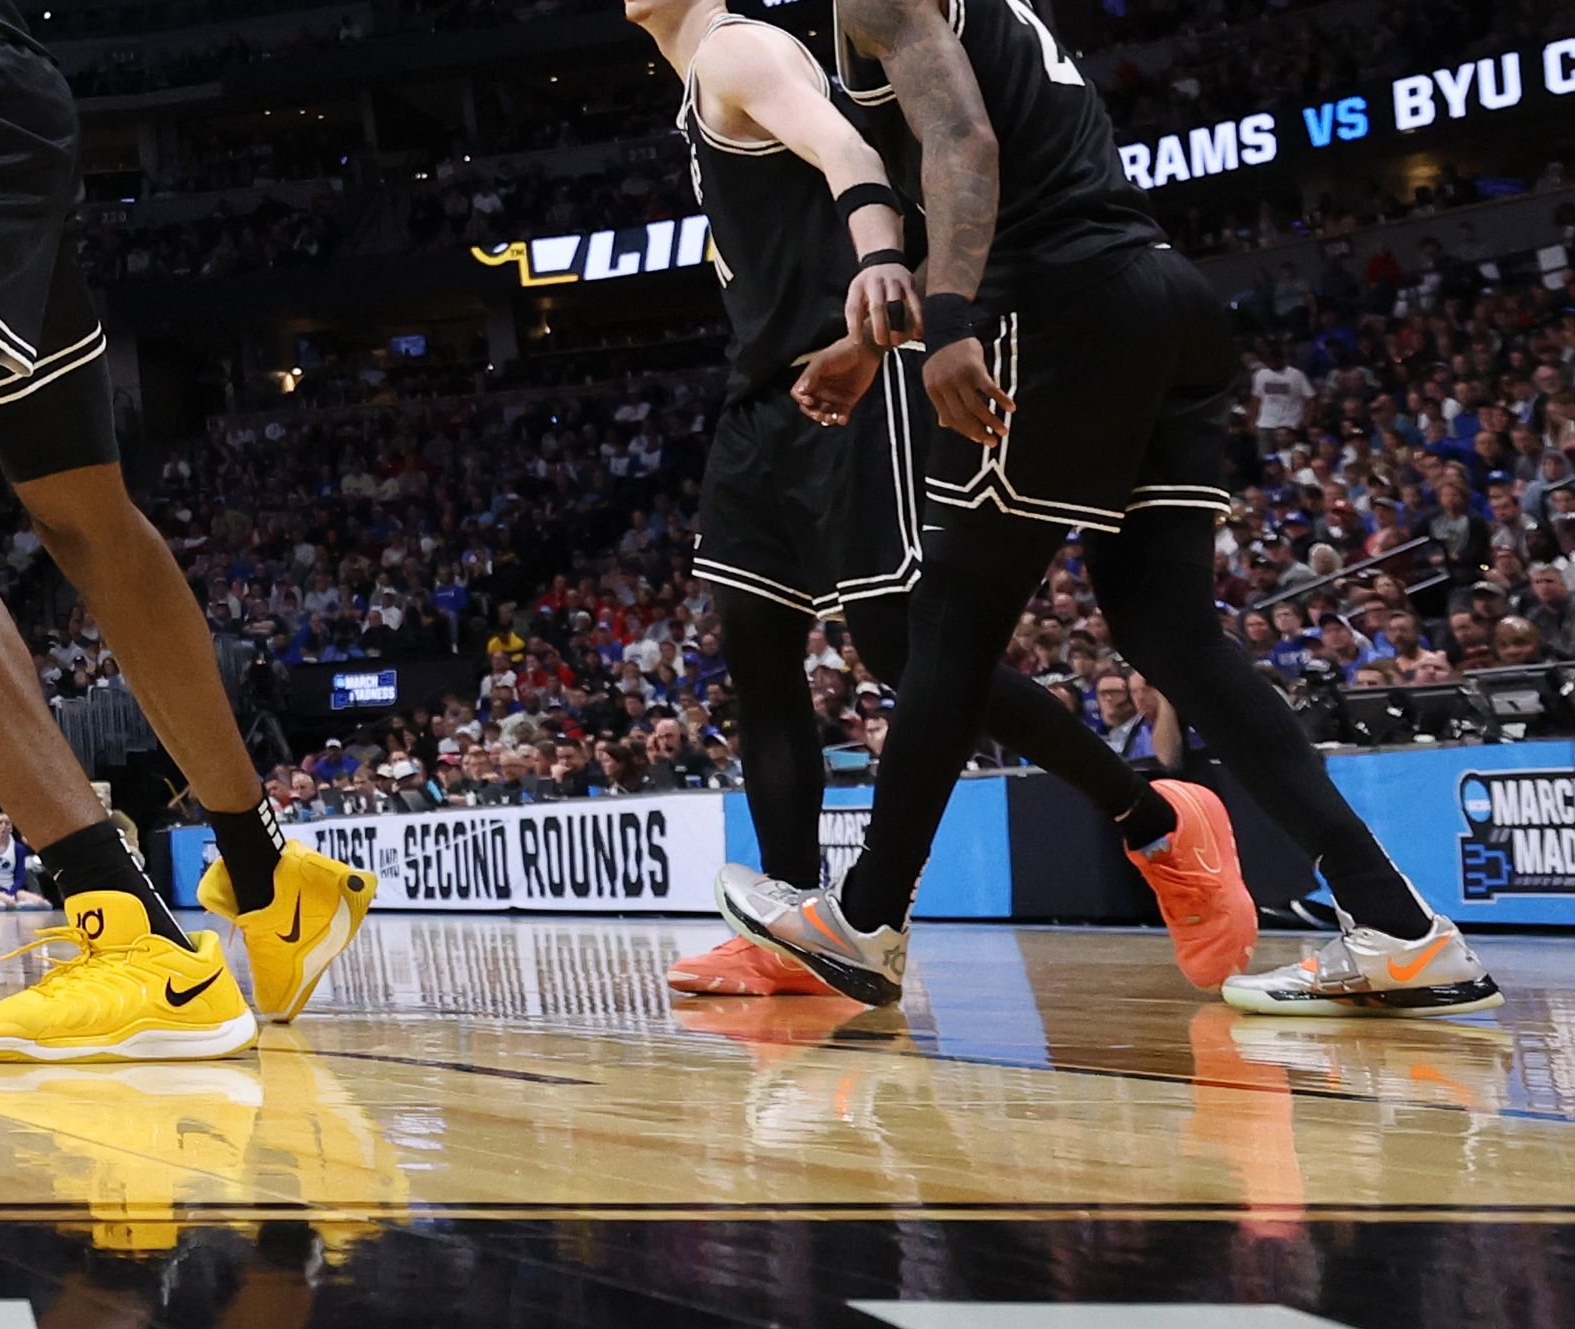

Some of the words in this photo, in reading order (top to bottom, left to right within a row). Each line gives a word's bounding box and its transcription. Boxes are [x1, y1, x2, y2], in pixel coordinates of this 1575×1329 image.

[1302, 95, 1370, 149] VS
[1392, 51, 1523, 133] BYU
[403, 819, 513, 900] SECOND
[519, 809, 671, 900] ROUNDS
